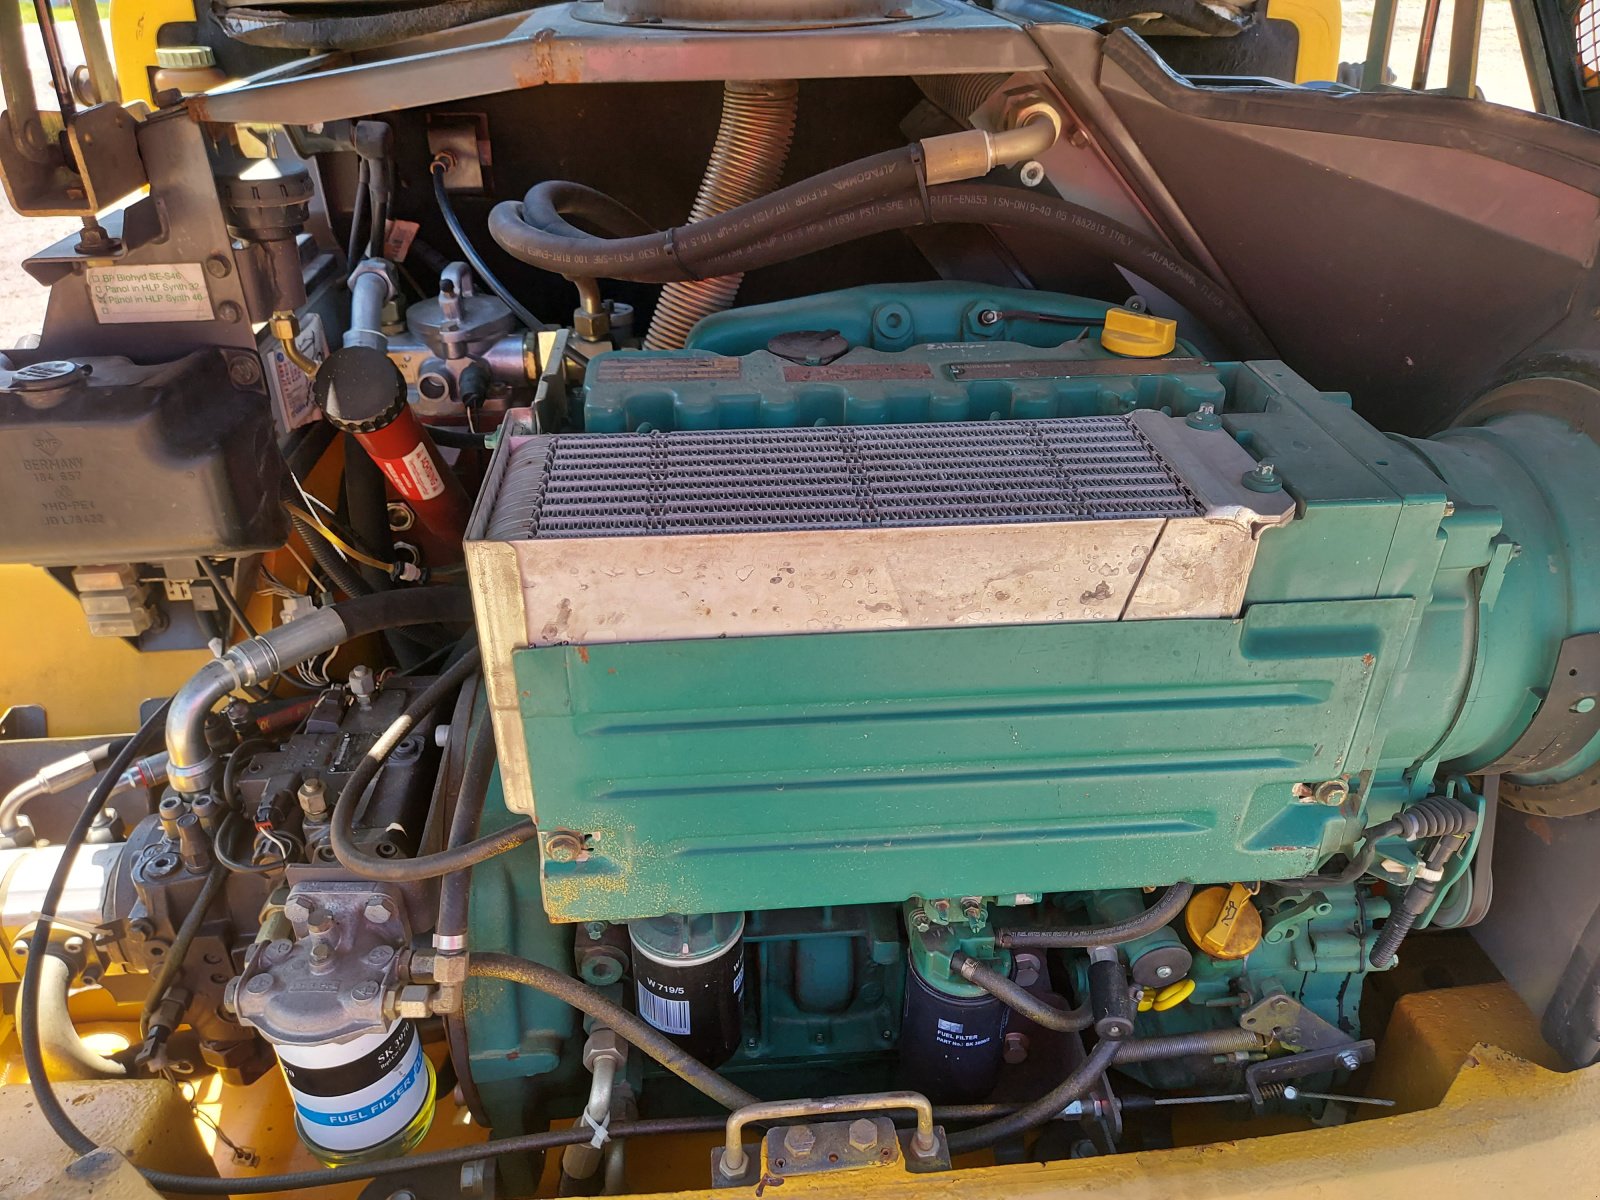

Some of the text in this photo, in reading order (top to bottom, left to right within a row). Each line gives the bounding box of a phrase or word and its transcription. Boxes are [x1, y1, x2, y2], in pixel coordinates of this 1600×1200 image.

[834, 163, 897, 192] ALFAGOMMA
[1108, 226, 1134, 247] ITALY
[117, 273, 148, 284] Biohyd
[132, 285, 141, 293] in
[143, 283, 160, 292] HLP
[162, 282, 186, 293] Synth
[187, 282, 200, 291] 32
[135, 294, 144, 303] in
[145, 293, 163, 303] HLP
[166, 293, 190, 304] Synth
[23, 456, 83, 471] GERMANY
[646, 976, 685, 995] W 719/5
[936, 1036, 952, 1045] PART
[937, 1029, 954, 1040] FUEL
[377, 1047, 394, 1064] SK
[329, 1076, 412, 1125] FUEL FILTER
